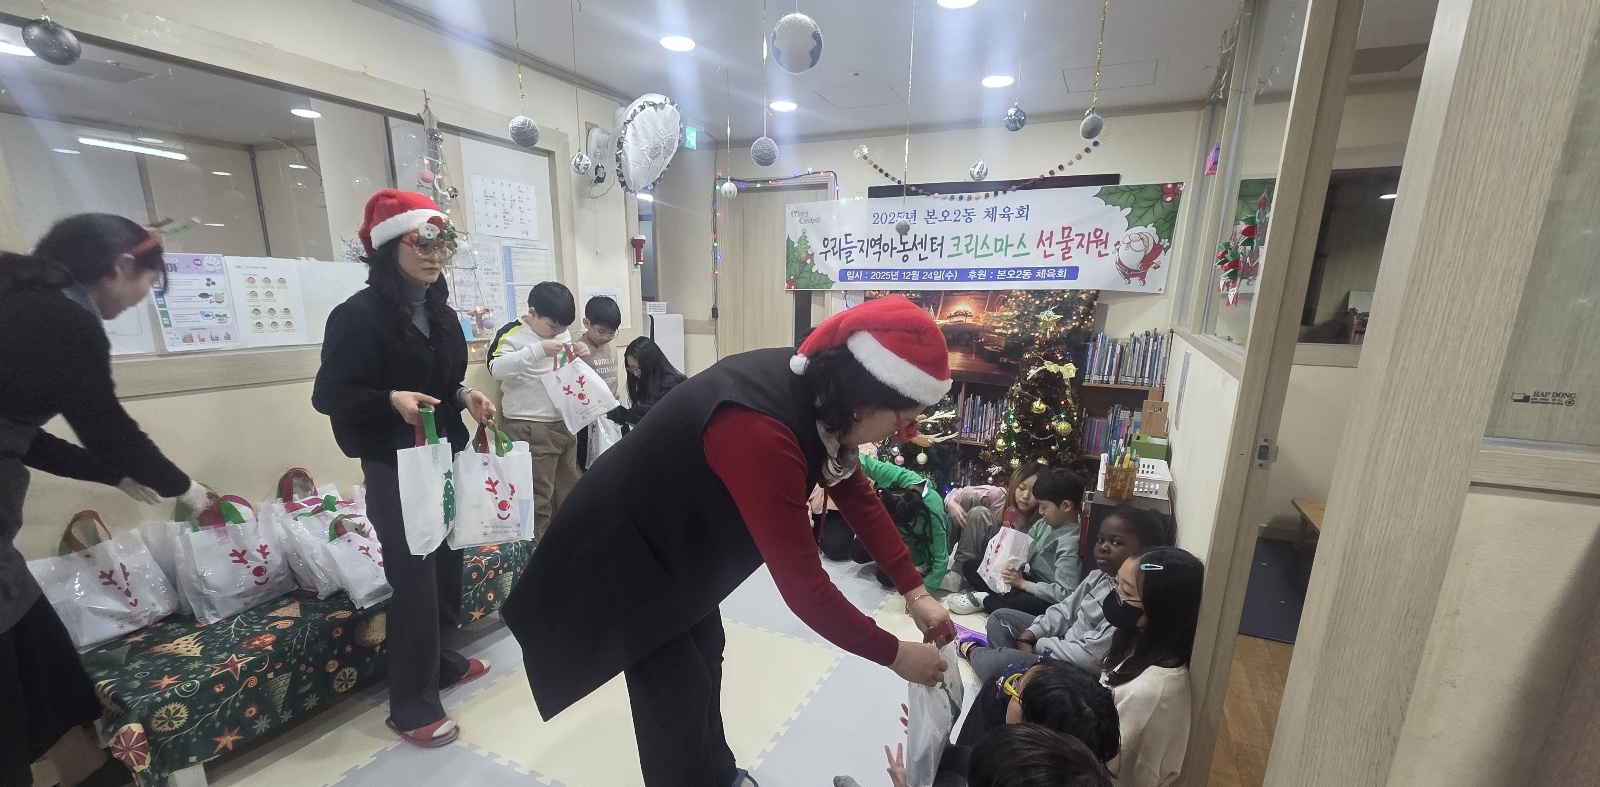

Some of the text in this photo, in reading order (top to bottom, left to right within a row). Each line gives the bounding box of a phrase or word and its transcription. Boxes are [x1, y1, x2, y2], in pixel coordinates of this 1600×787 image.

[872, 204, 1030, 225] 2025년 본오2동 체육회
[947, 232, 1031, 259] 크리스마스
[846, 271, 863, 281] 일시
[870, 271, 899, 281] 2025년
[902, 271, 920, 281] 12월
[922, 270, 958, 281] 24일(수)
[967, 269, 987, 280] 후원
[996, 269, 1032, 280] 본오2동
[1035, 268, 1068, 279] 체육회
[1551, 391, 1576, 399] DONG
